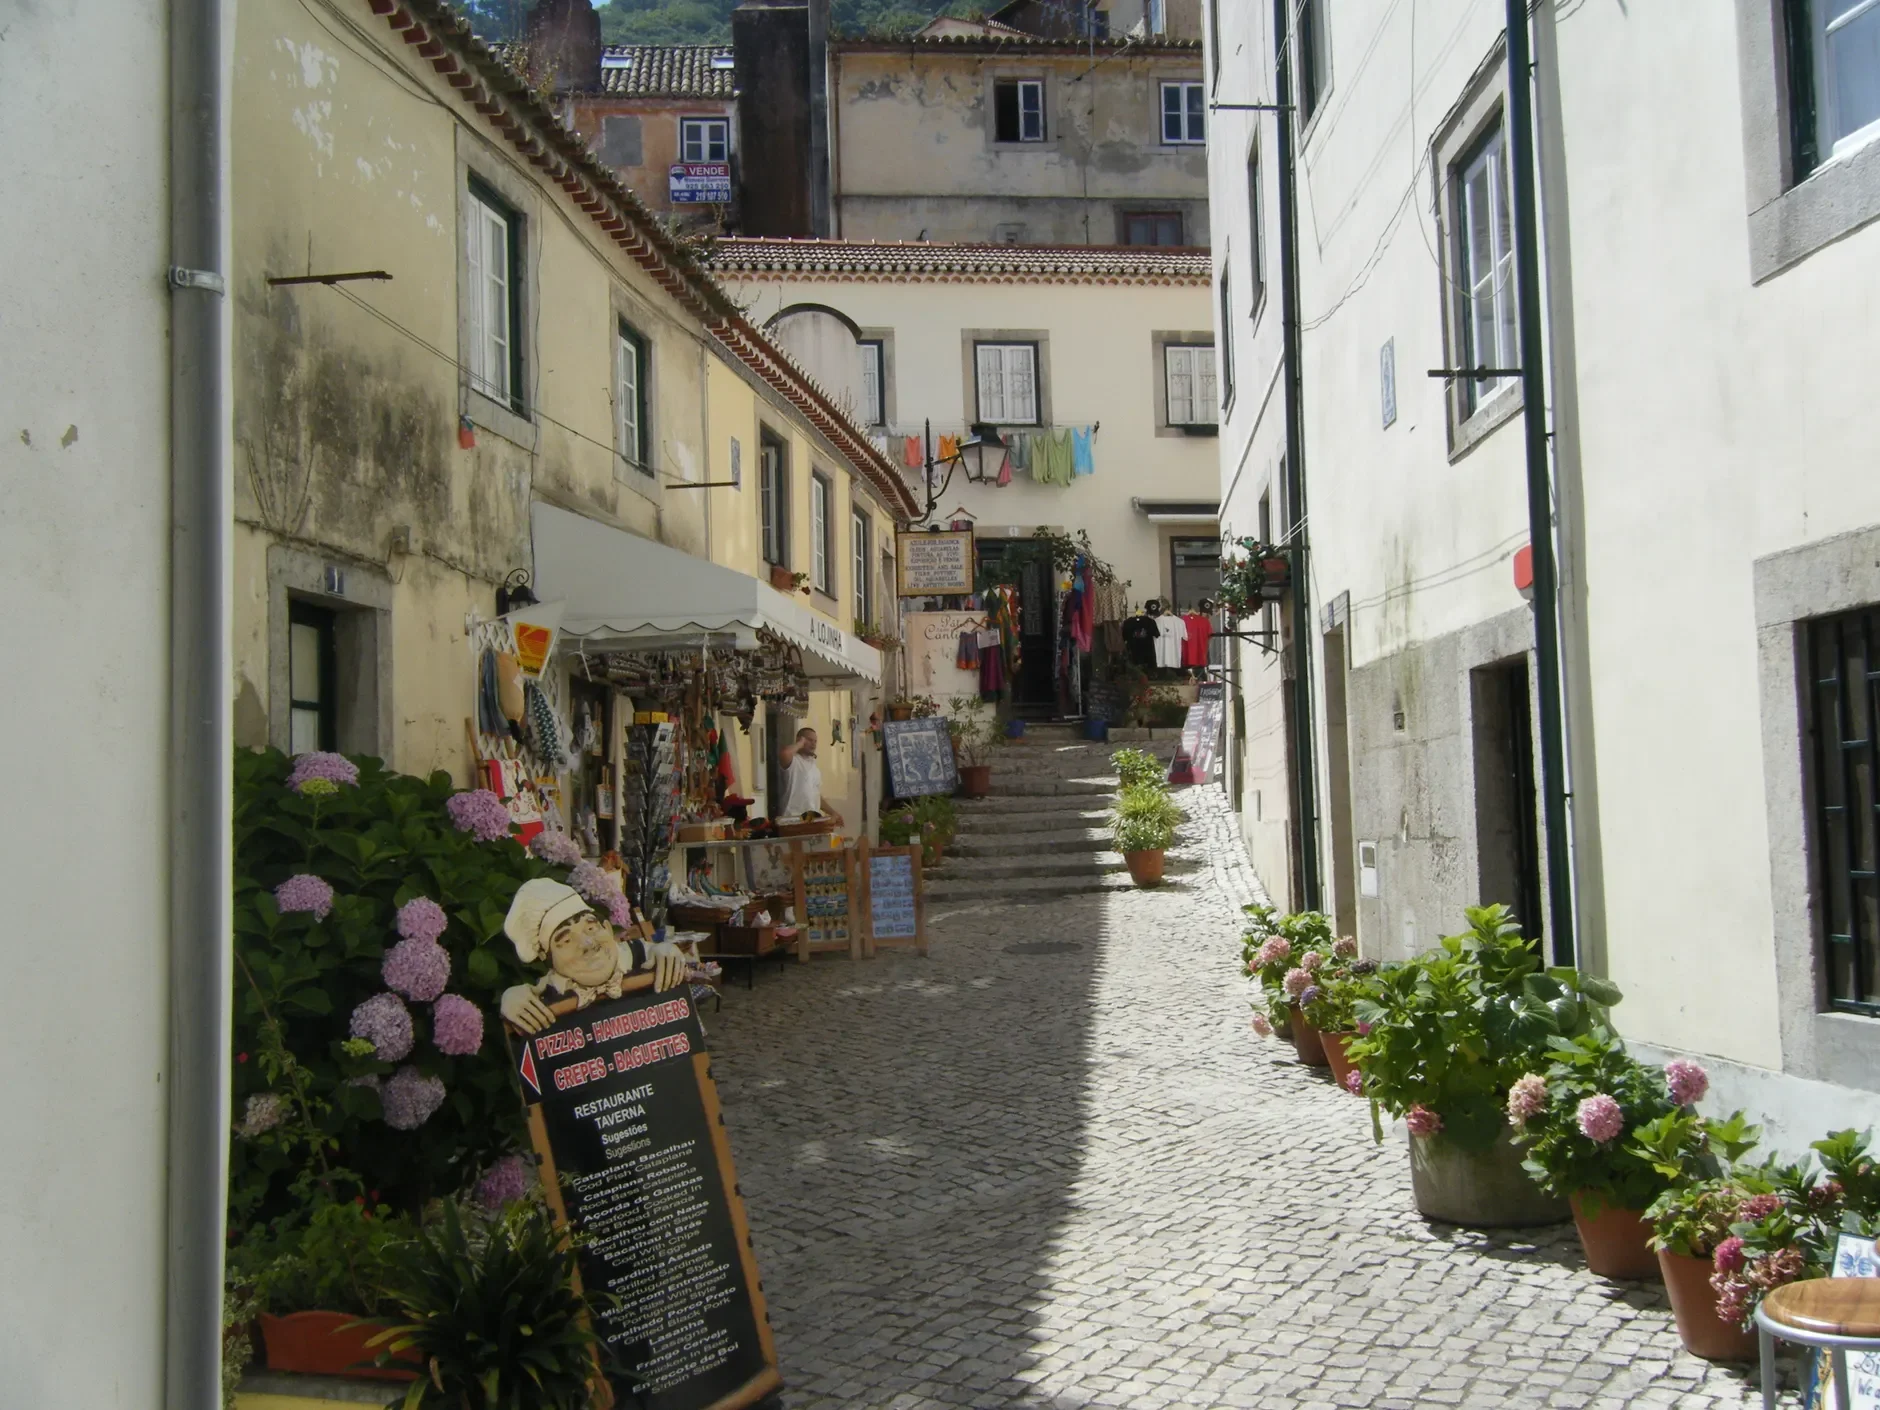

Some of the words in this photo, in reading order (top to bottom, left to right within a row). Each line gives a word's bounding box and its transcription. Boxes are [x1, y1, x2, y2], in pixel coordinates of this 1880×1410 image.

[689, 167, 724, 175] VENDE
[810, 616, 815, 639] A
[818, 622, 842, 652] LOJINHA
[535, 1027, 585, 1060] PIZZAS
[592, 998, 690, 1043] HAMBURGUERS
[554, 1057, 607, 1091] CREPES
[613, 1032, 690, 1072] BAGUETTES
[574, 1083, 654, 1119] RESTAURANTE
[594, 1104, 646, 1130] TAVERNA
[602, 1123, 648, 1145] Sugestões
[605, 1138, 652, 1160] Sugestions
[572, 1160, 636, 1186] Cataplana
[639, 1140, 695, 1162] Bacalhau
[578, 1180, 602, 1192] Cod
[606, 1170, 632, 1182] Fish
[635, 1148, 692, 1172] Cataplana
[584, 1178, 644, 1201] Cataplana
[647, 1162, 687, 1179] Robalo
[579, 1199, 608, 1212] Rock
[611, 1188, 640, 1201] Bass
[642, 1166, 697, 1190] Cataplana
[584, 1202, 630, 1223] Açorda
[634, 1195, 649, 1204] de
[653, 1175, 703, 1197] Gambas
[588, 1207, 640, 1229] Seafood
[644, 1189, 688, 1210] Cooked
[691, 1184, 702, 1192] In
[589, 1224, 646, 1249] Bacalhau
[649, 1214, 674, 1226] com
[677, 1201, 709, 1216] Natas
[613, 1212, 650, 1229] Bread
[653, 1195, 695, 1214] Parada
[592, 1243, 616, 1255] Cod
[620, 1238, 630, 1246] In
[633, 1222, 670, 1240] Cream
[674, 1209, 707, 1225] Sauce
[604, 1235, 662, 1260] Bacalhau
[612, 1254, 636, 1266] Cod
[639, 1242, 666, 1256] With
[668, 1230, 700, 1245] Chips
[607, 1262, 665, 1287] Sardinha
[668, 1243, 712, 1264] Assada
[616, 1275, 656, 1293] Grilled
[659, 1254, 708, 1277] Sardines
[633, 1255, 656, 1268] and
[659, 1243, 687, 1258] Eggs
[686, 1260, 714, 1275] Style
[609, 1311, 637, 1325] Pork
[640, 1299, 664, 1313] Ribs
[667, 1288, 693, 1301] With
[695, 1272, 727, 1290] Bread
[639, 1290, 665, 1303] com
[668, 1263, 730, 1292] Entrecosto
[607, 1317, 664, 1343] Grelhado
[668, 1301, 703, 1318] Porco
[705, 1287, 736, 1302] Preto
[622, 1298, 686, 1328] Portuguese
[690, 1285, 716, 1300] Style
[624, 1324, 664, 1345] Grilled
[667, 1310, 701, 1327] Black
[703, 1298, 731, 1312] Pork
[636, 1349, 680, 1371] Frango
[683, 1328, 728, 1351] Cerveja
[649, 1319, 705, 1346] Lasanha
[653, 1326, 708, 1354] Lasagna
[690, 1350, 701, 1358] In
[703, 1338, 729, 1352] Beer
[632, 1361, 697, 1393] Enrecote
[700, 1354, 716, 1364] de
[718, 1342, 739, 1356] Boi
[693, 1356, 728, 1375] Steak
